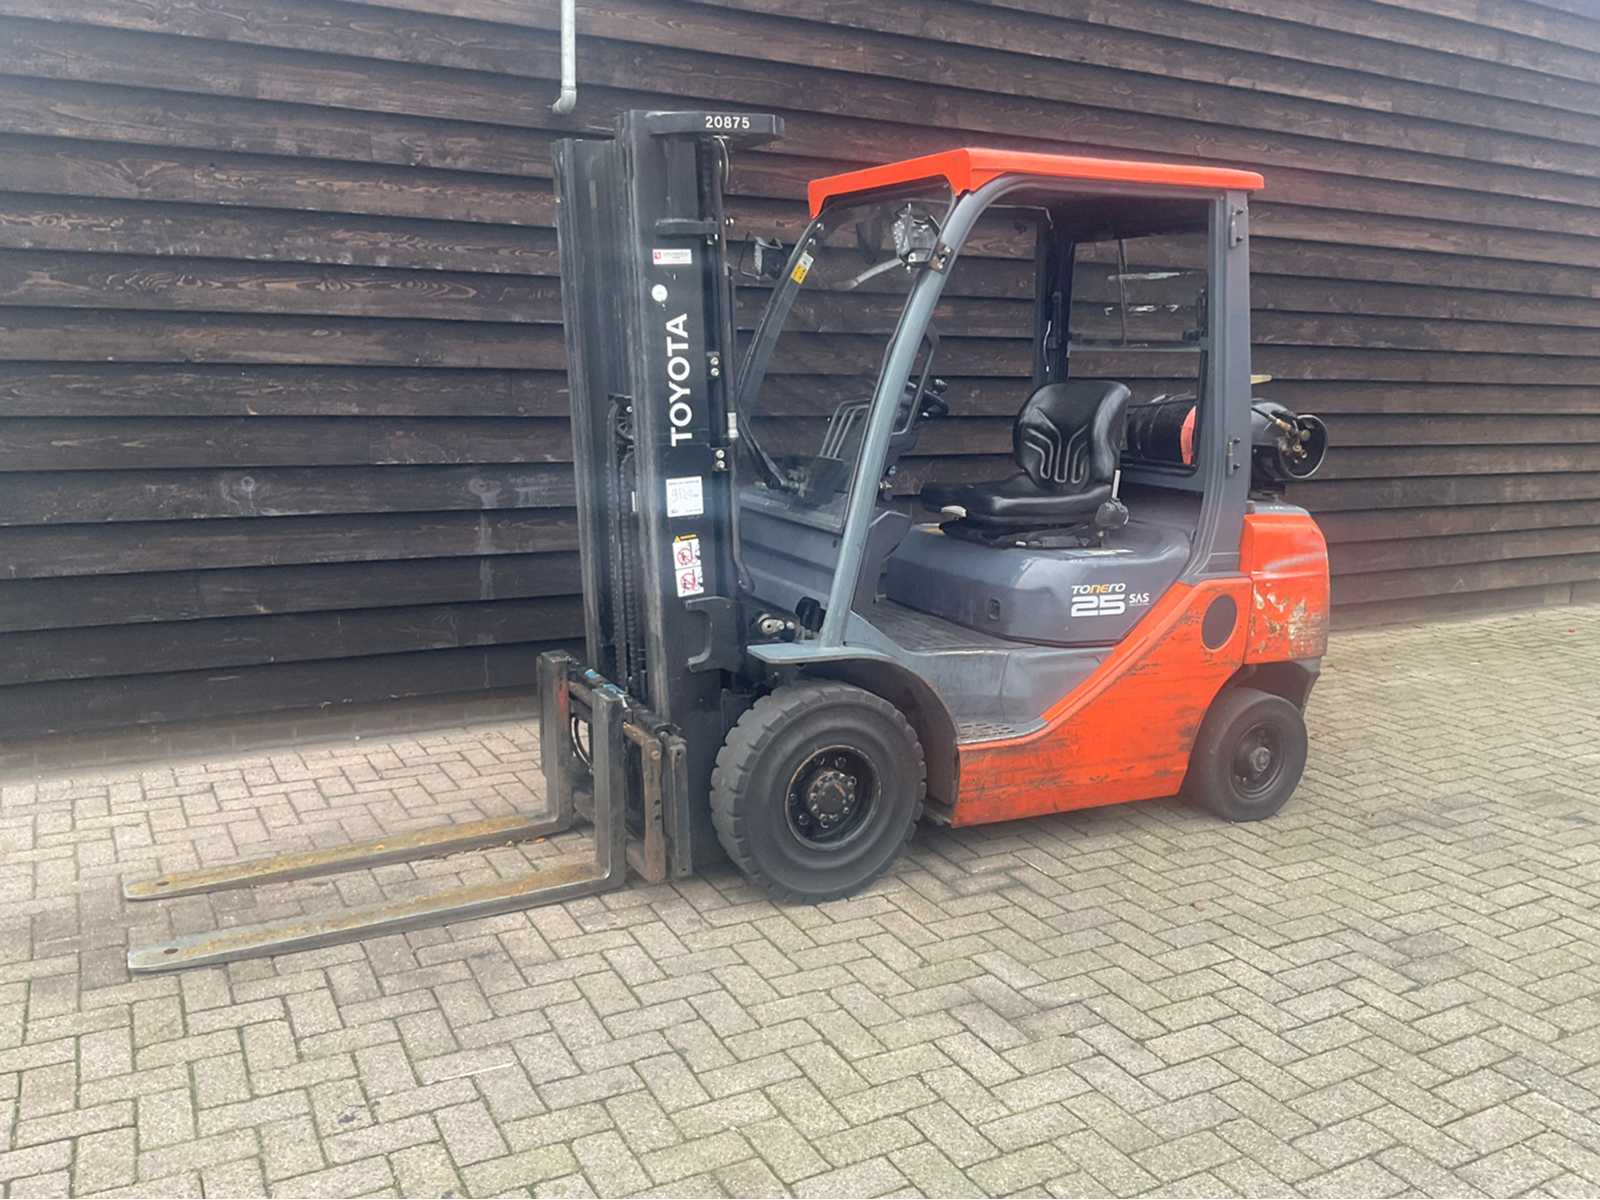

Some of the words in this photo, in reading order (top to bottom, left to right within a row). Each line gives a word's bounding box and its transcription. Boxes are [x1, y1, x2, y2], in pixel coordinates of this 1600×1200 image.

[705, 116, 751, 129] 20875
[666, 313, 693, 447] TOYOTA
[1071, 594, 1126, 617] 25
[1129, 593, 1150, 603] SAS
